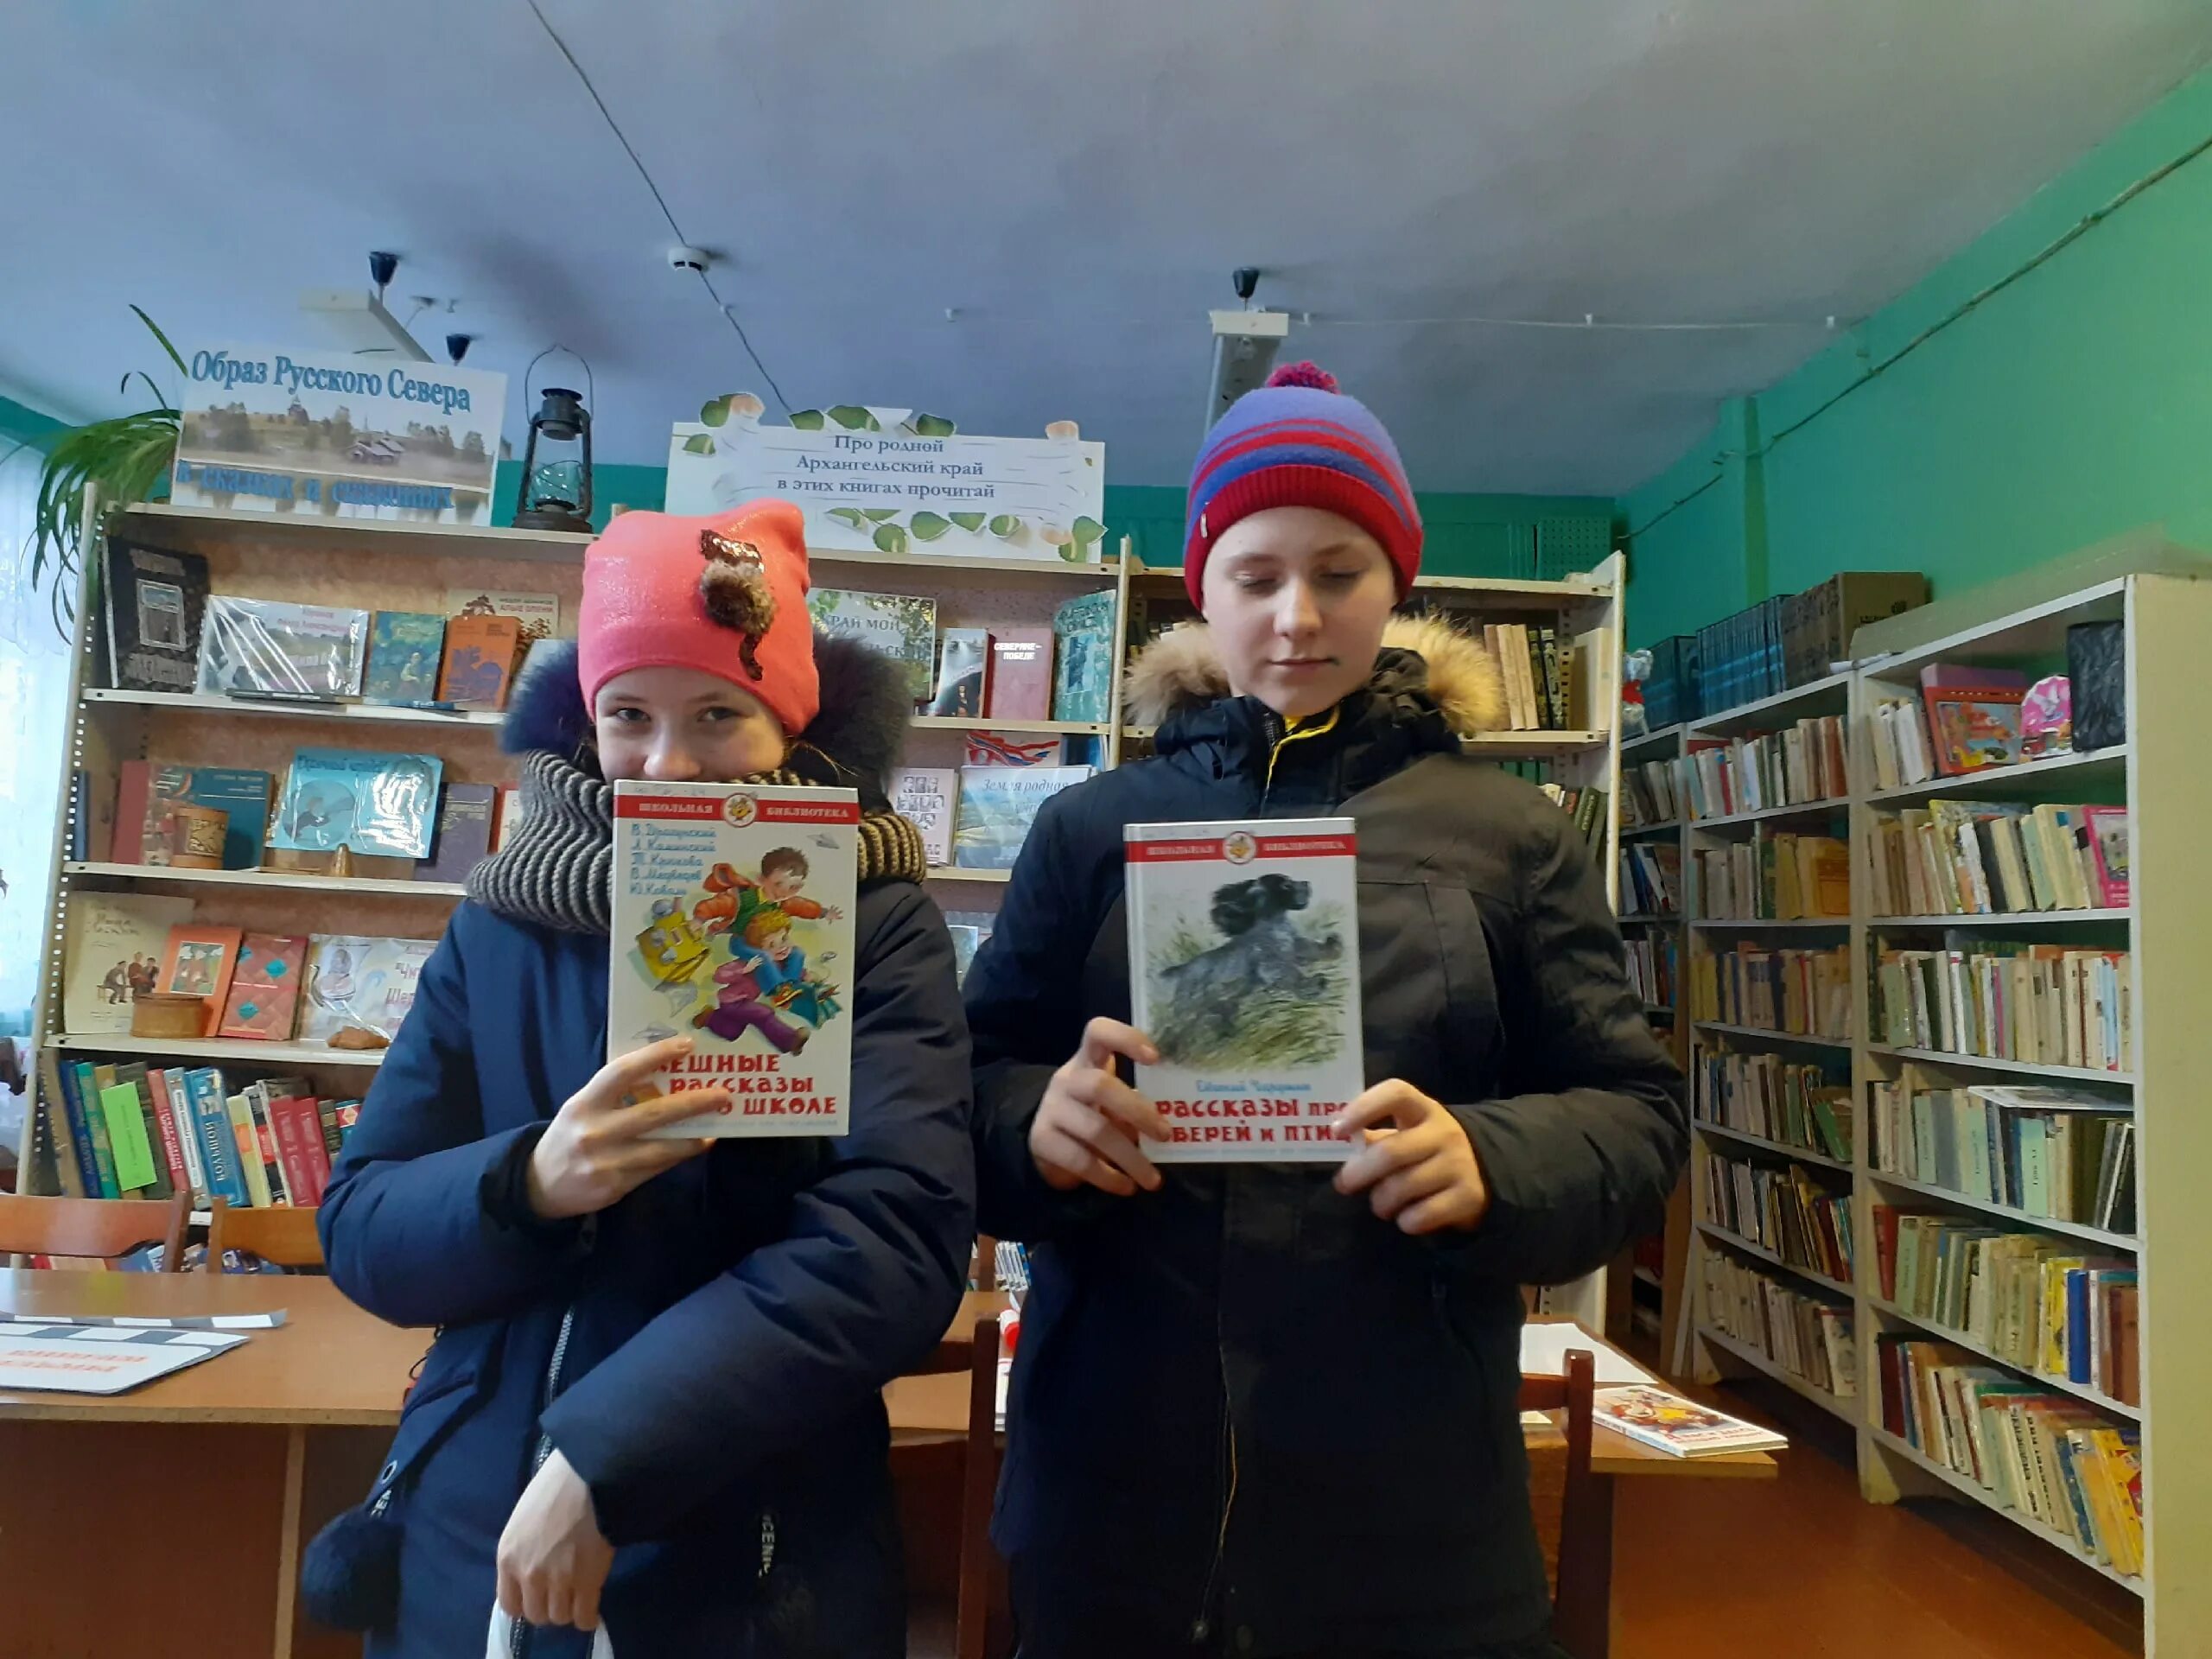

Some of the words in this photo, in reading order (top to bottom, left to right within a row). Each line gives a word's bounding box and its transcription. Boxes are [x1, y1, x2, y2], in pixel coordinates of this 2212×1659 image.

[192, 350, 268, 390] Образ
[273, 355, 383, 395] Русского
[387, 368, 471, 415] Севера
[834, 435, 874, 454] Про
[878, 440, 944, 455] родной
[796, 455, 934, 475] Архангельский
[940, 461, 983, 478] край
[778, 479, 787, 490] в
[791, 480, 833, 493] этих
[838, 480, 901, 496] книгах
[908, 482, 995, 499] прочитай
[825, 614, 861, 628] РАЙ
[639, 803, 713, 814] ШКОЛЬНАЯ
[766, 806, 849, 817] БИБЛИОТЕКА
[659, 1053, 780, 1073] ЕШНЫЕ
[743, 1096, 837, 1116] ШКОЛЕ
[1170, 1120, 1253, 1142] ВЕРЕЙ
